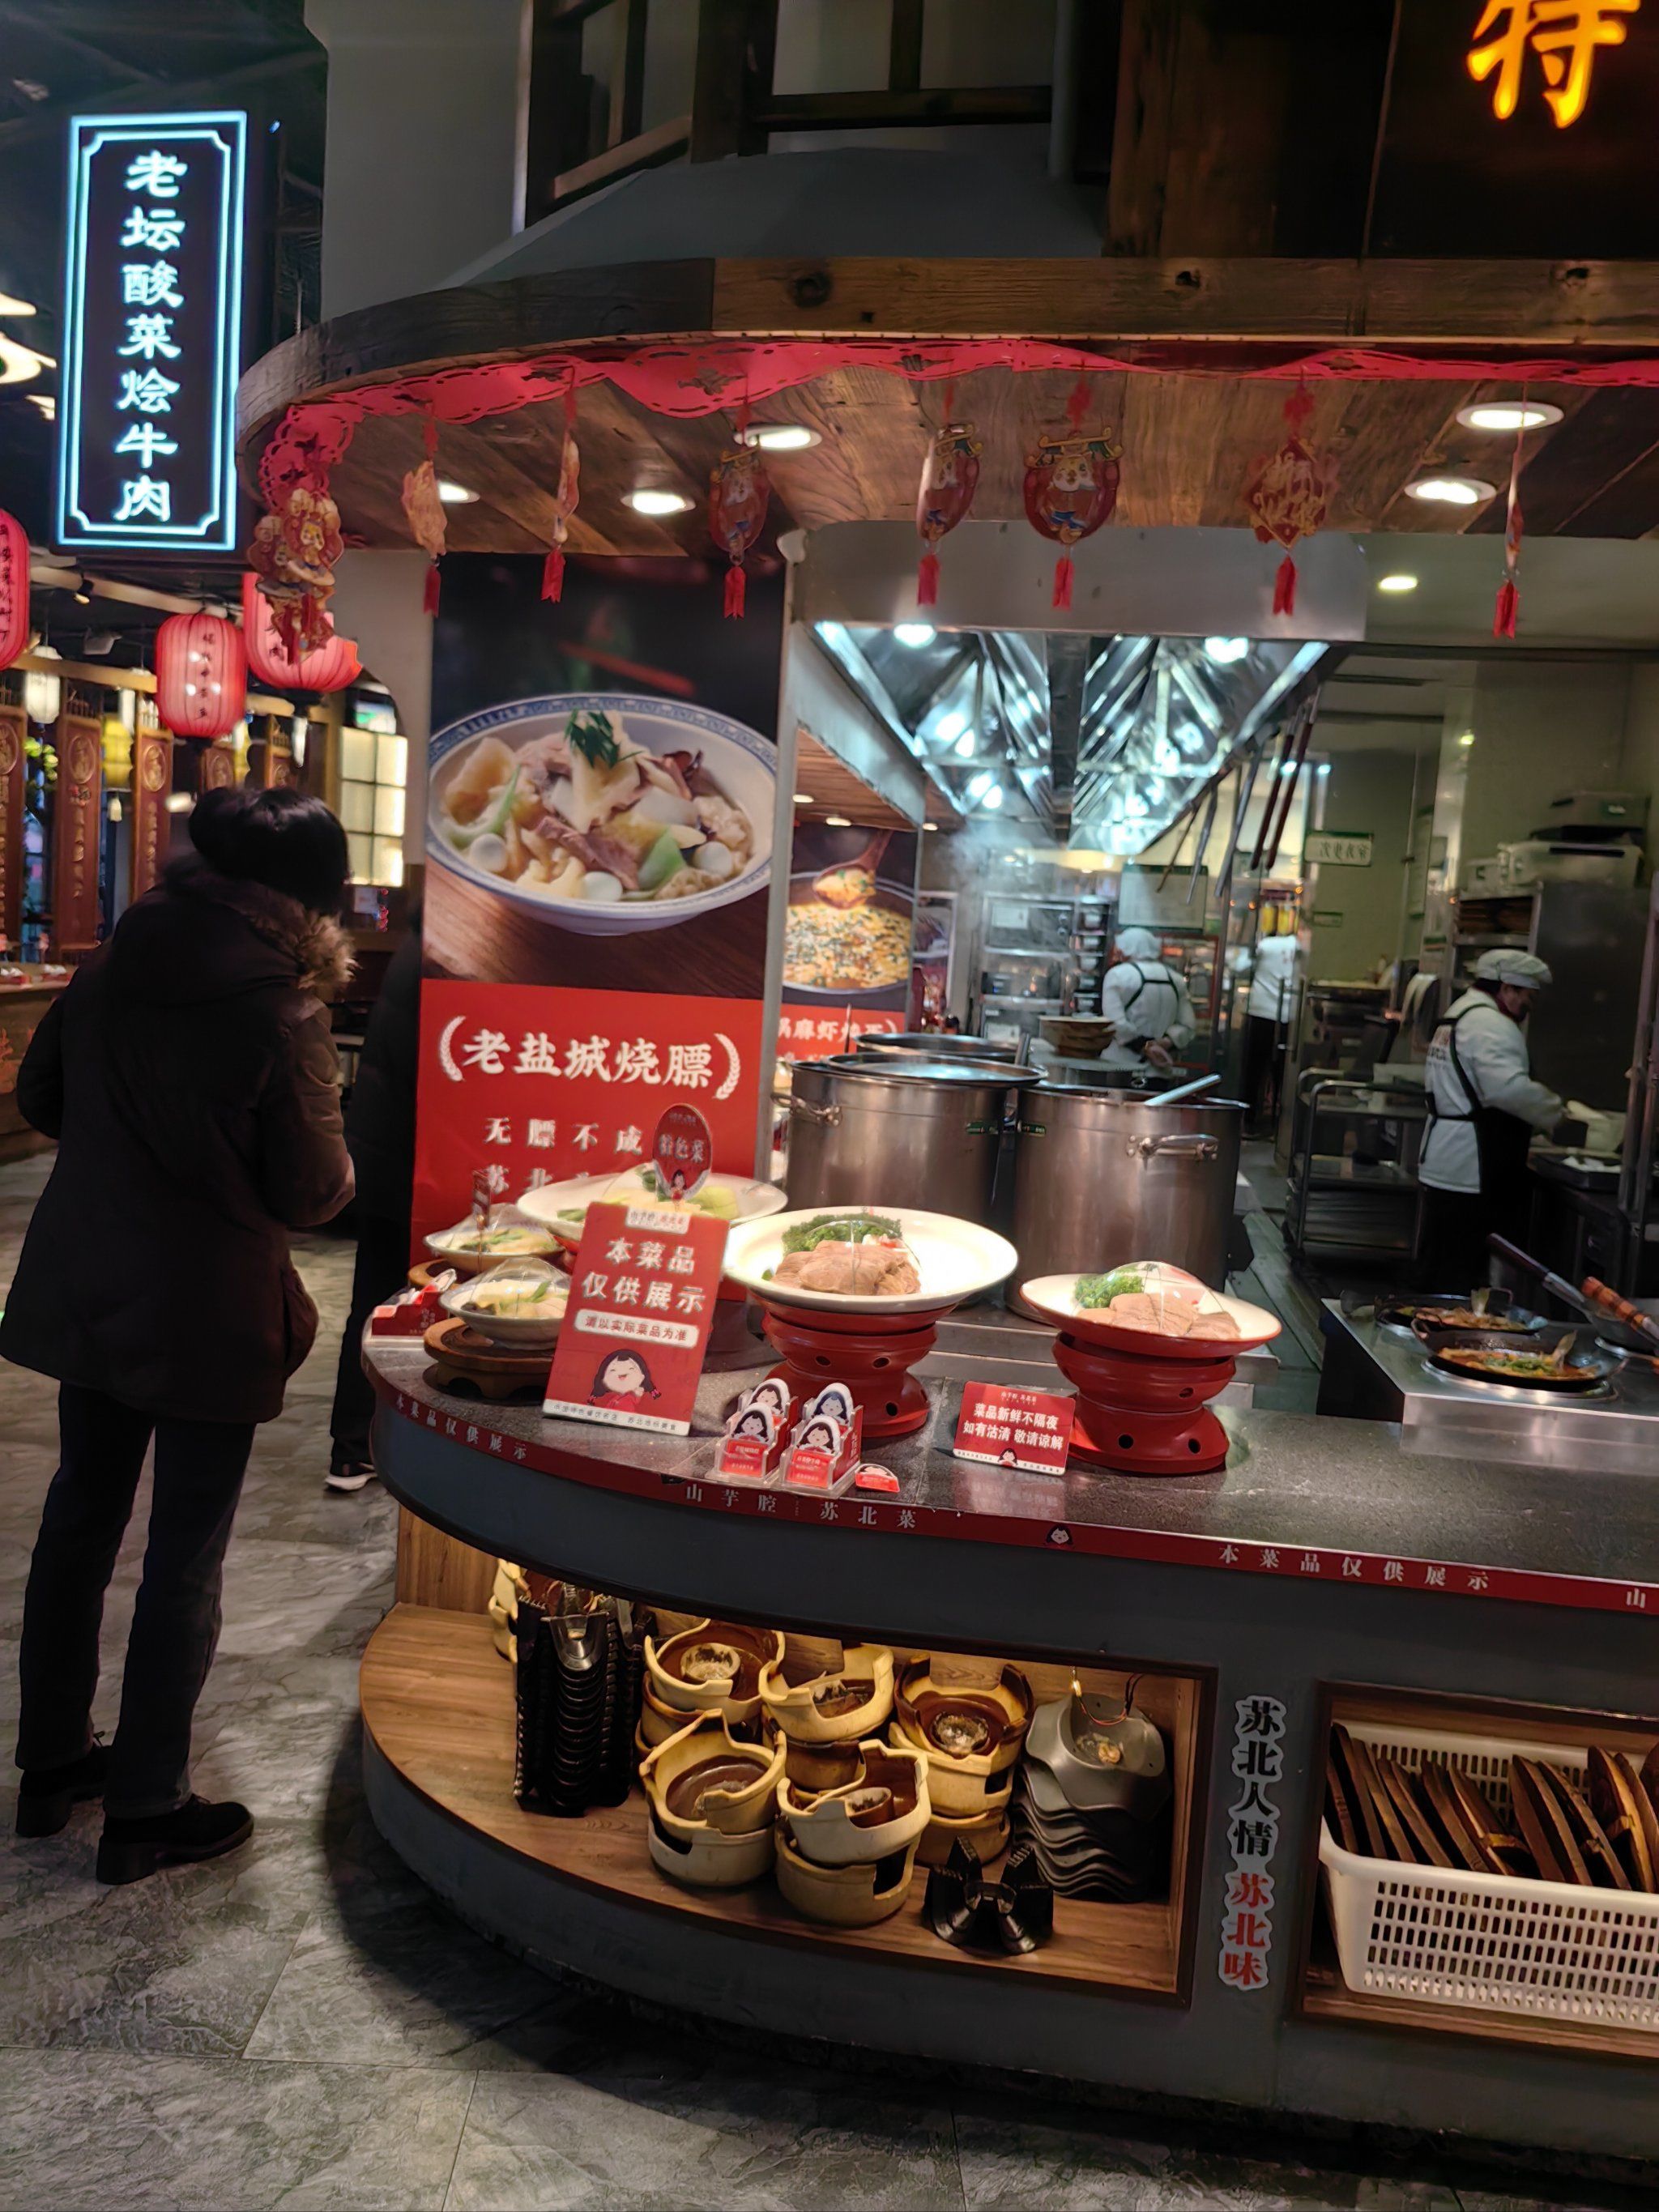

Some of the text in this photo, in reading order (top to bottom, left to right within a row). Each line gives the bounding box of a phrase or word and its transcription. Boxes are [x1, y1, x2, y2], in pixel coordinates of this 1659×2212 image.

[113, 150, 189, 522] 老坛酸菜烩牛肉
[461, 1028, 714, 1089] 老盐城烧膘
[485, 1164, 590, 1196] 苏北
[604, 1237, 696, 1276] 本菜品
[582, 1271, 706, 1315] 仅供展示
[584, 1315, 688, 1342] 请以实际菜品为准
[973, 1402, 1060, 1431] 菜品新鲜不隔夜
[962, 1420, 1064, 1451] 如有沽清 敬请谅解
[819, 1500, 917, 1530] 苏北菜
[1218, 1544, 1490, 1591] 本菜品仅供展示
[1626, 1587, 1646, 1609] 山
[1223, 1699, 1281, 1986] 苏北人情 苏北味
